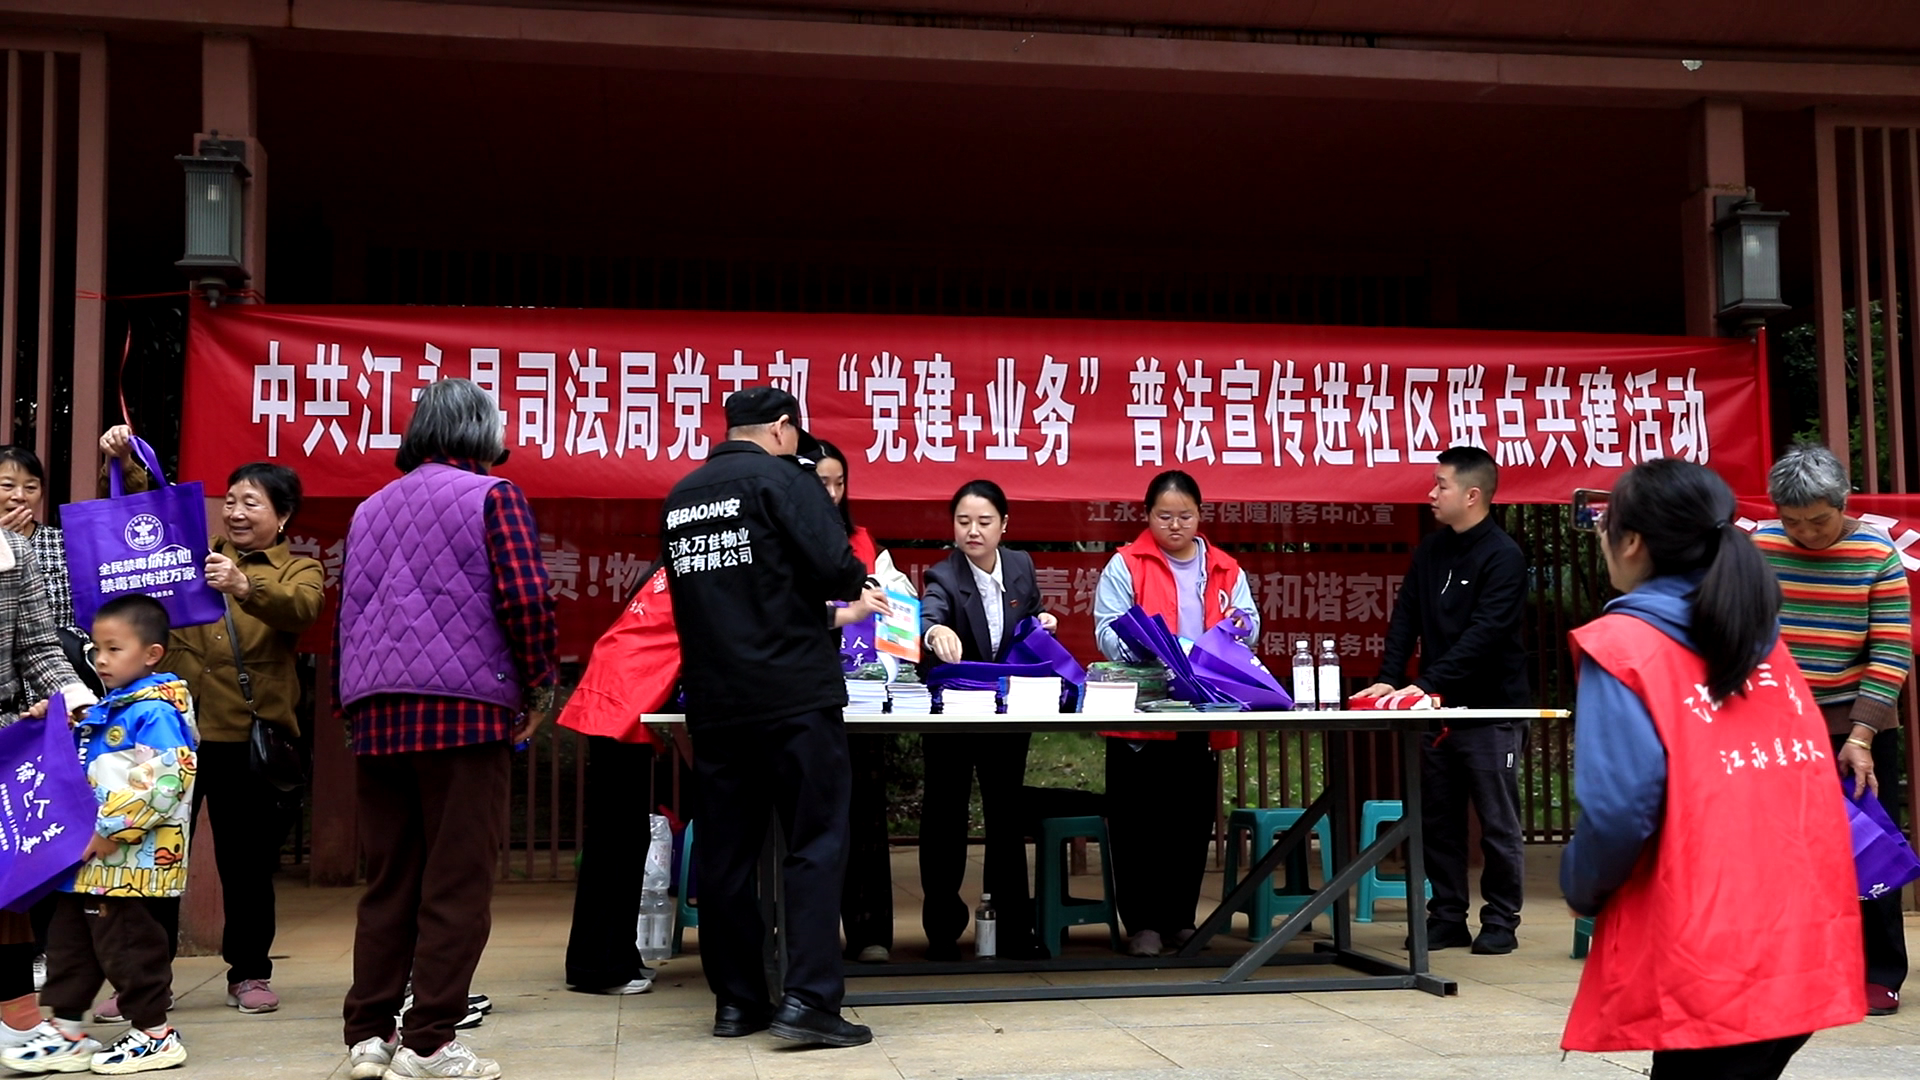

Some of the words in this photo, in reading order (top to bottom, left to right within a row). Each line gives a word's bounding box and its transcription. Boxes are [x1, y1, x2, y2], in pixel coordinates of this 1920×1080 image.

[100, 566, 197, 594] 禁毒宣传进万家
